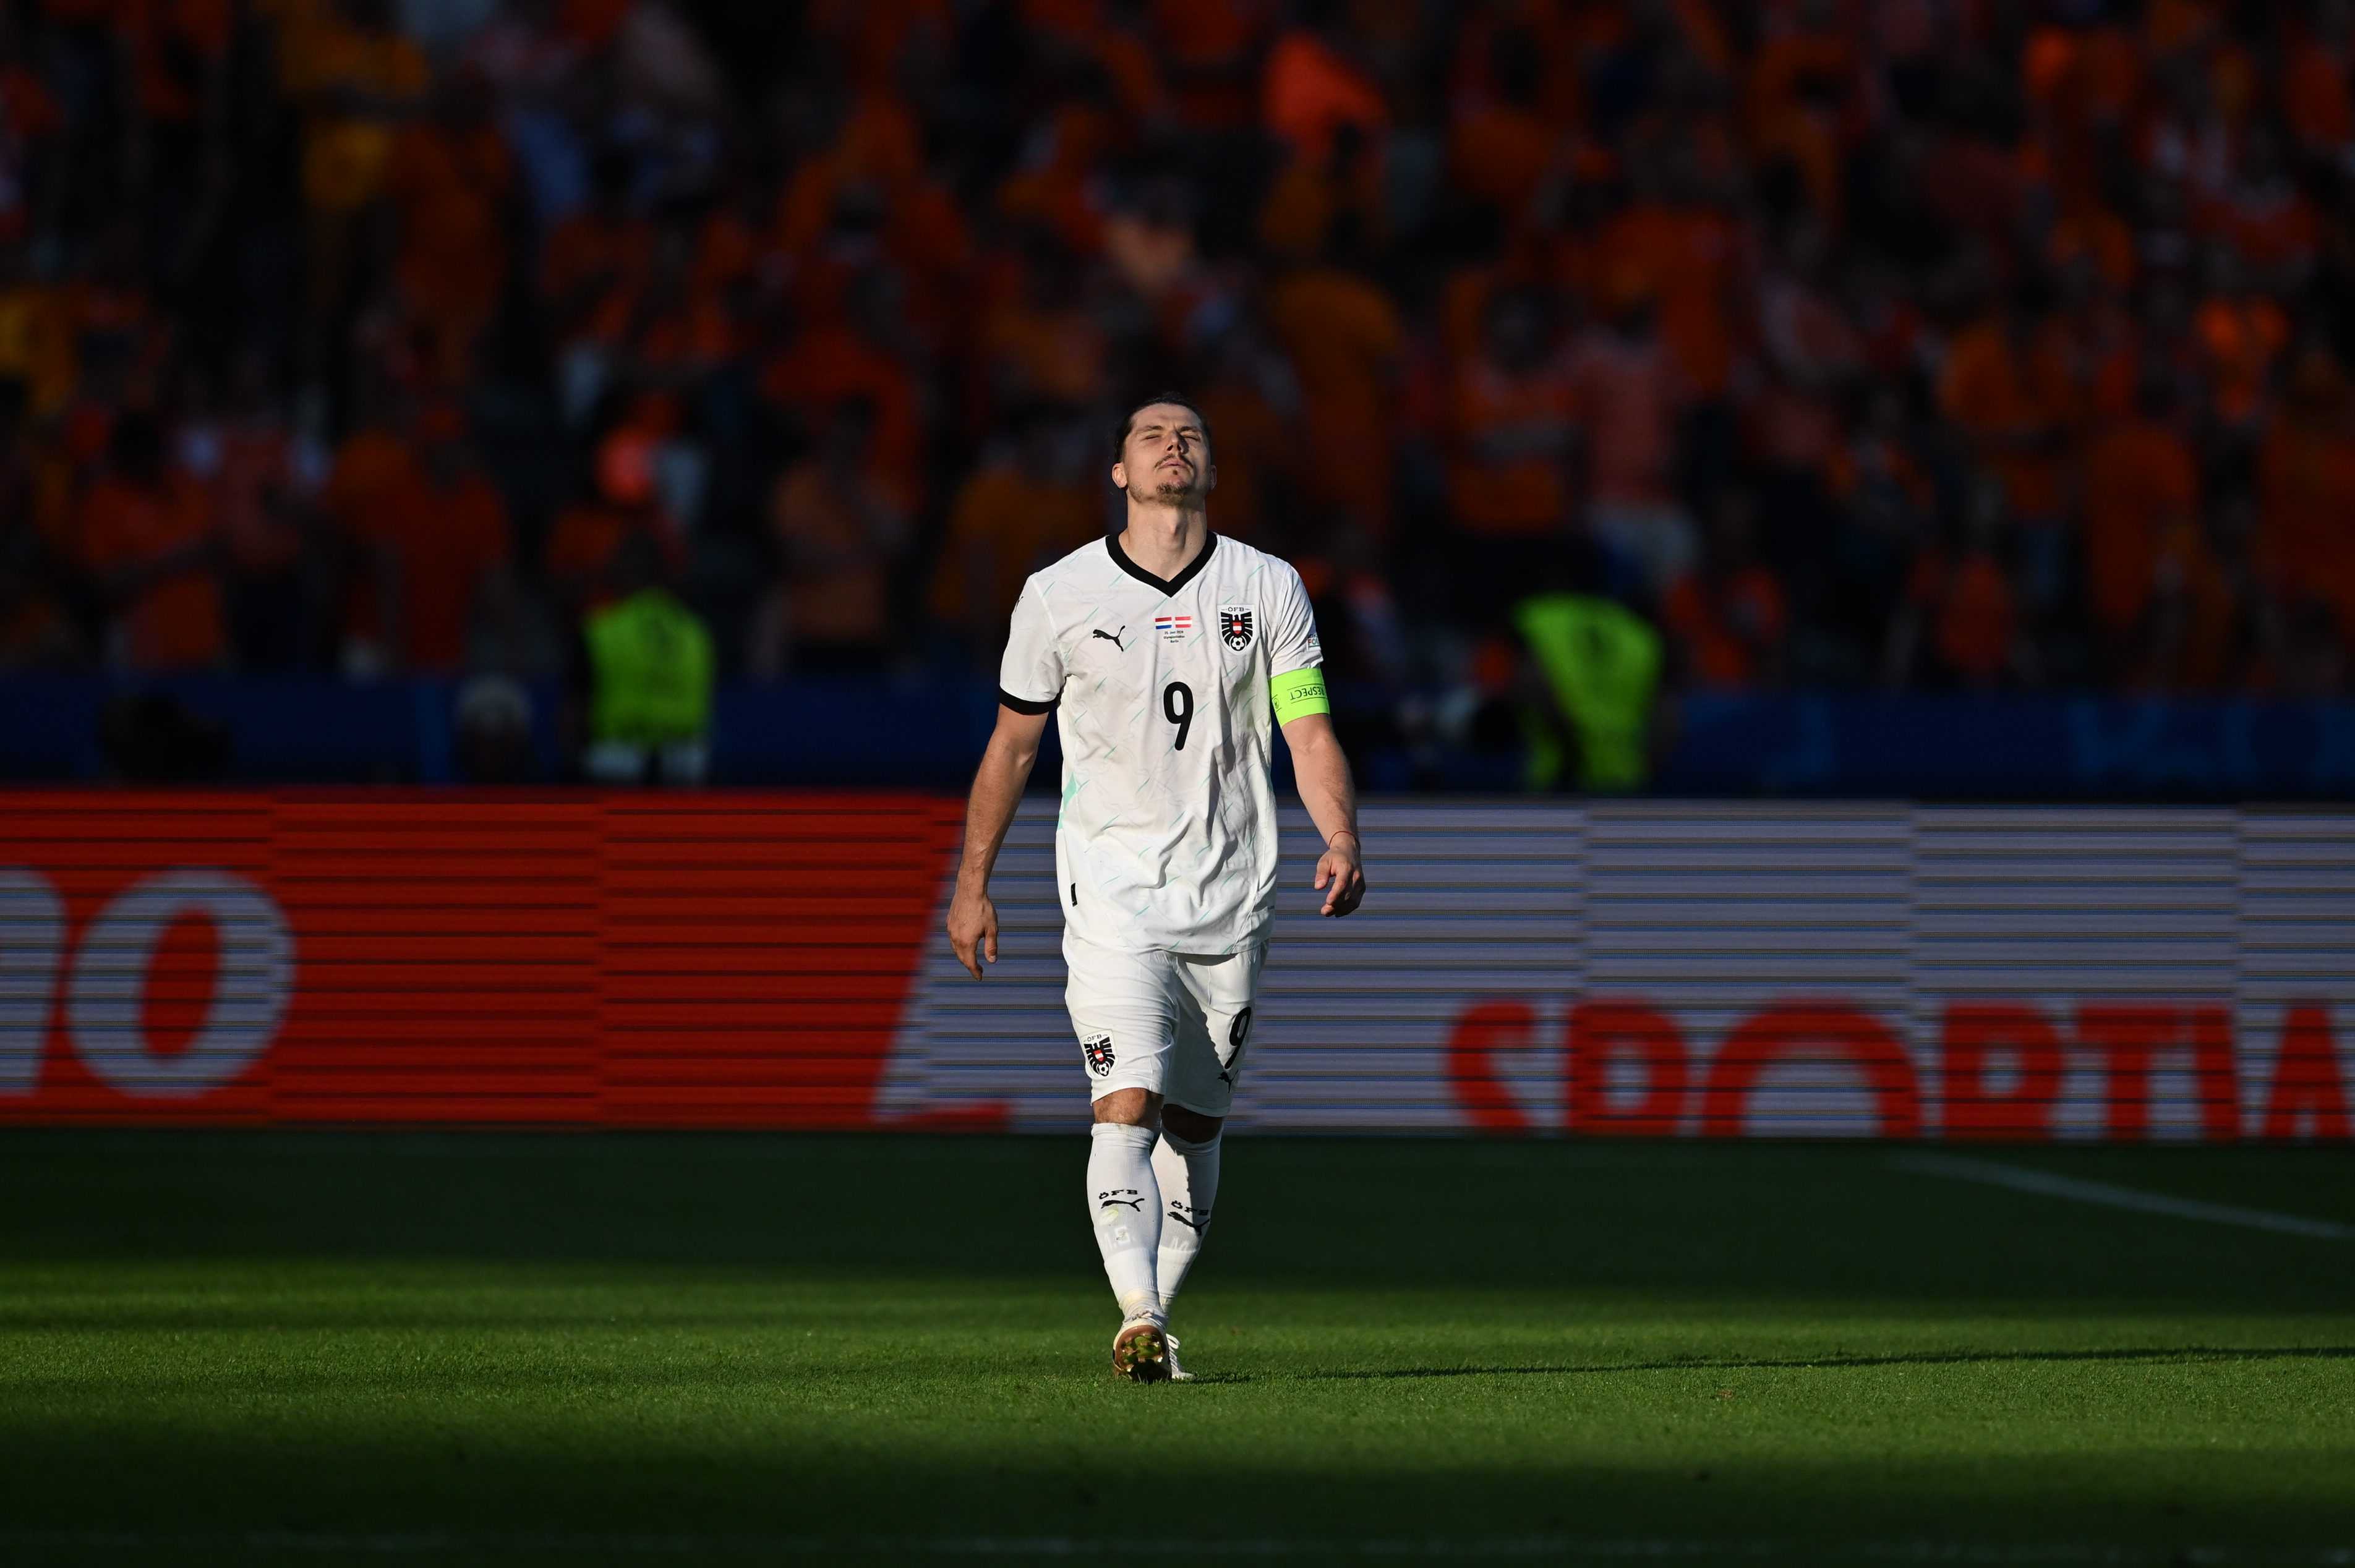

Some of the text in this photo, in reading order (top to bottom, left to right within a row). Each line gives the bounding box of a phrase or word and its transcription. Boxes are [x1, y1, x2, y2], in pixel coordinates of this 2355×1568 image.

[1290, 686, 1325, 701] RESPECT
[1163, 681, 1194, 751] 9
[1224, 1006, 1252, 1070] 9
[1099, 1189, 1139, 1199] ÖFB
[1171, 1200, 1209, 1216] ÖFB
